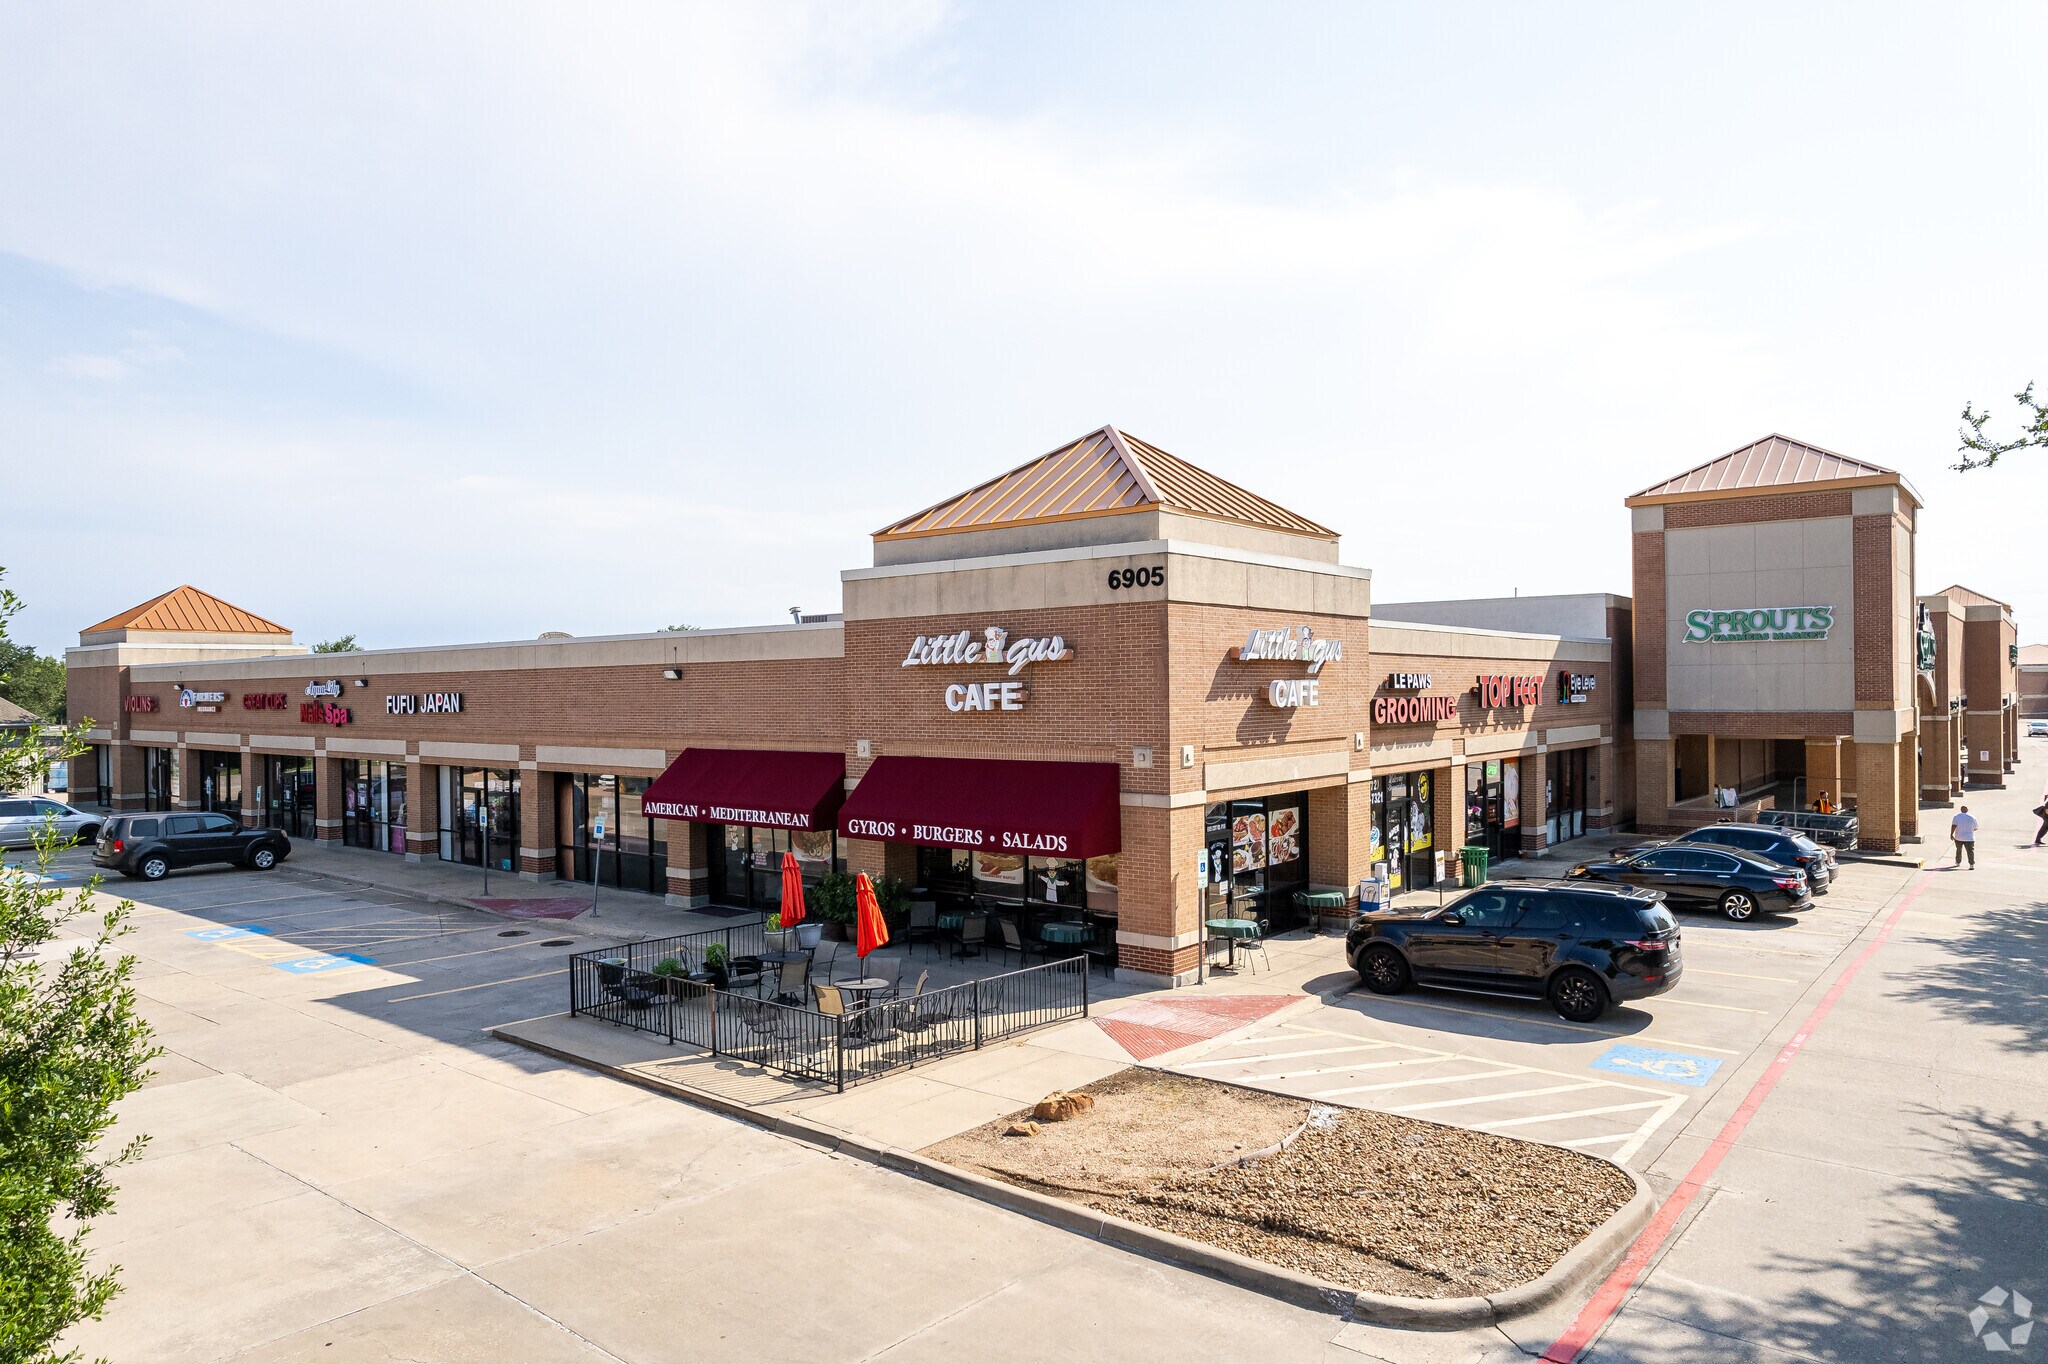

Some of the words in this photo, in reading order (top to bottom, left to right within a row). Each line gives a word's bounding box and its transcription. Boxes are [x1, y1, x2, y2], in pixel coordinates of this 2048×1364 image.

[1108, 566, 1165, 590] 6905
[1683, 607, 1833, 641] SPROUTS
[1713, 632, 1769, 641] FARMERS
[1772, 630, 1827, 640] MARKET
[902, 630, 982, 667] Little
[1007, 636, 1064, 675] gus
[1240, 627, 1298, 661] Little
[1307, 639, 1342, 673] gus
[1269, 680, 1319, 707] CAFE
[1394, 674, 1407, 689] LE
[1407, 673, 1432, 689] PAWS
[1480, 674, 1511, 709] TOP
[1513, 675, 1543, 707] FEET
[124, 695, 152, 712] VIOLINS
[386, 694, 415, 714] FUFU
[420, 692, 460, 713] JAPAN
[945, 682, 1023, 712] CAFE
[1374, 696, 1457, 724] GROOMING
[301, 701, 324, 723] Nails
[325, 703, 348, 727] Spa
[644, 802, 698, 817] AMERICAN
[710, 806, 810, 827] MEDITERRANEAN
[848, 819, 895, 837] GYROS
[913, 825, 983, 845] BURGERS
[1002, 832, 1067, 851] SALADS
